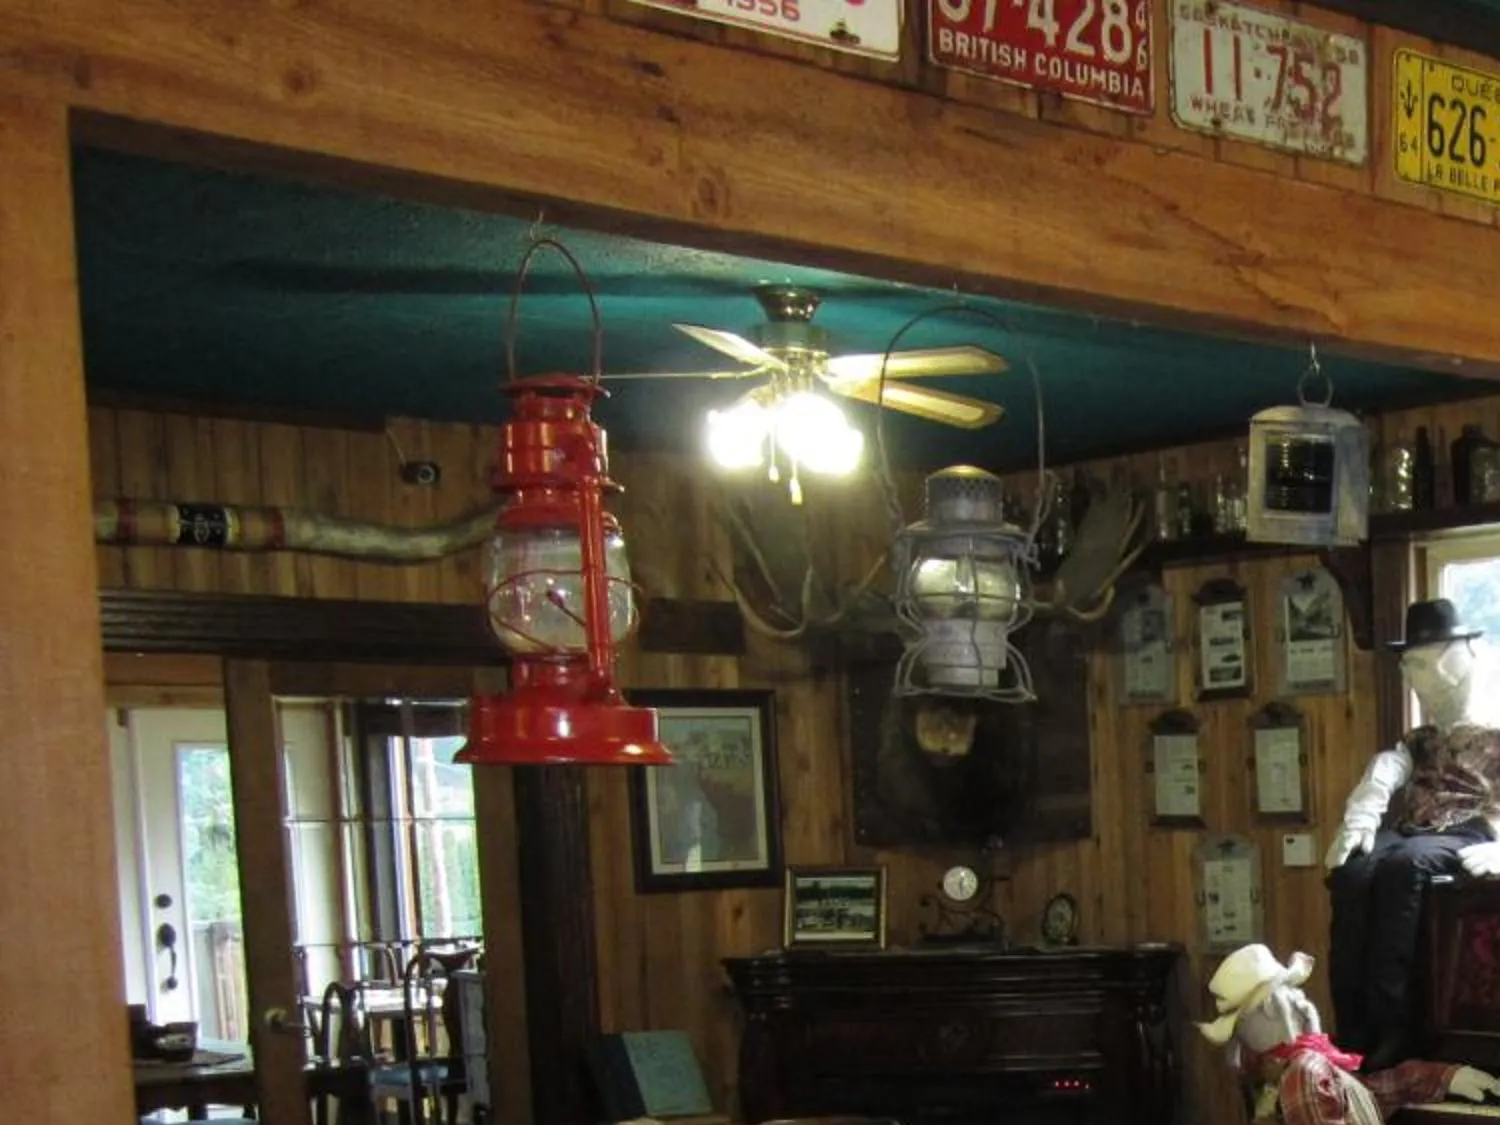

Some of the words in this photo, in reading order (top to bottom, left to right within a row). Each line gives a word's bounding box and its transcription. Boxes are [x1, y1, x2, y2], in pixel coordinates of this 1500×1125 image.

[938, 27, 1027, 71] BRITISH
[1034, 52, 1144, 98] COLUMBIA
[1450, 168, 1489, 193] BELLE
